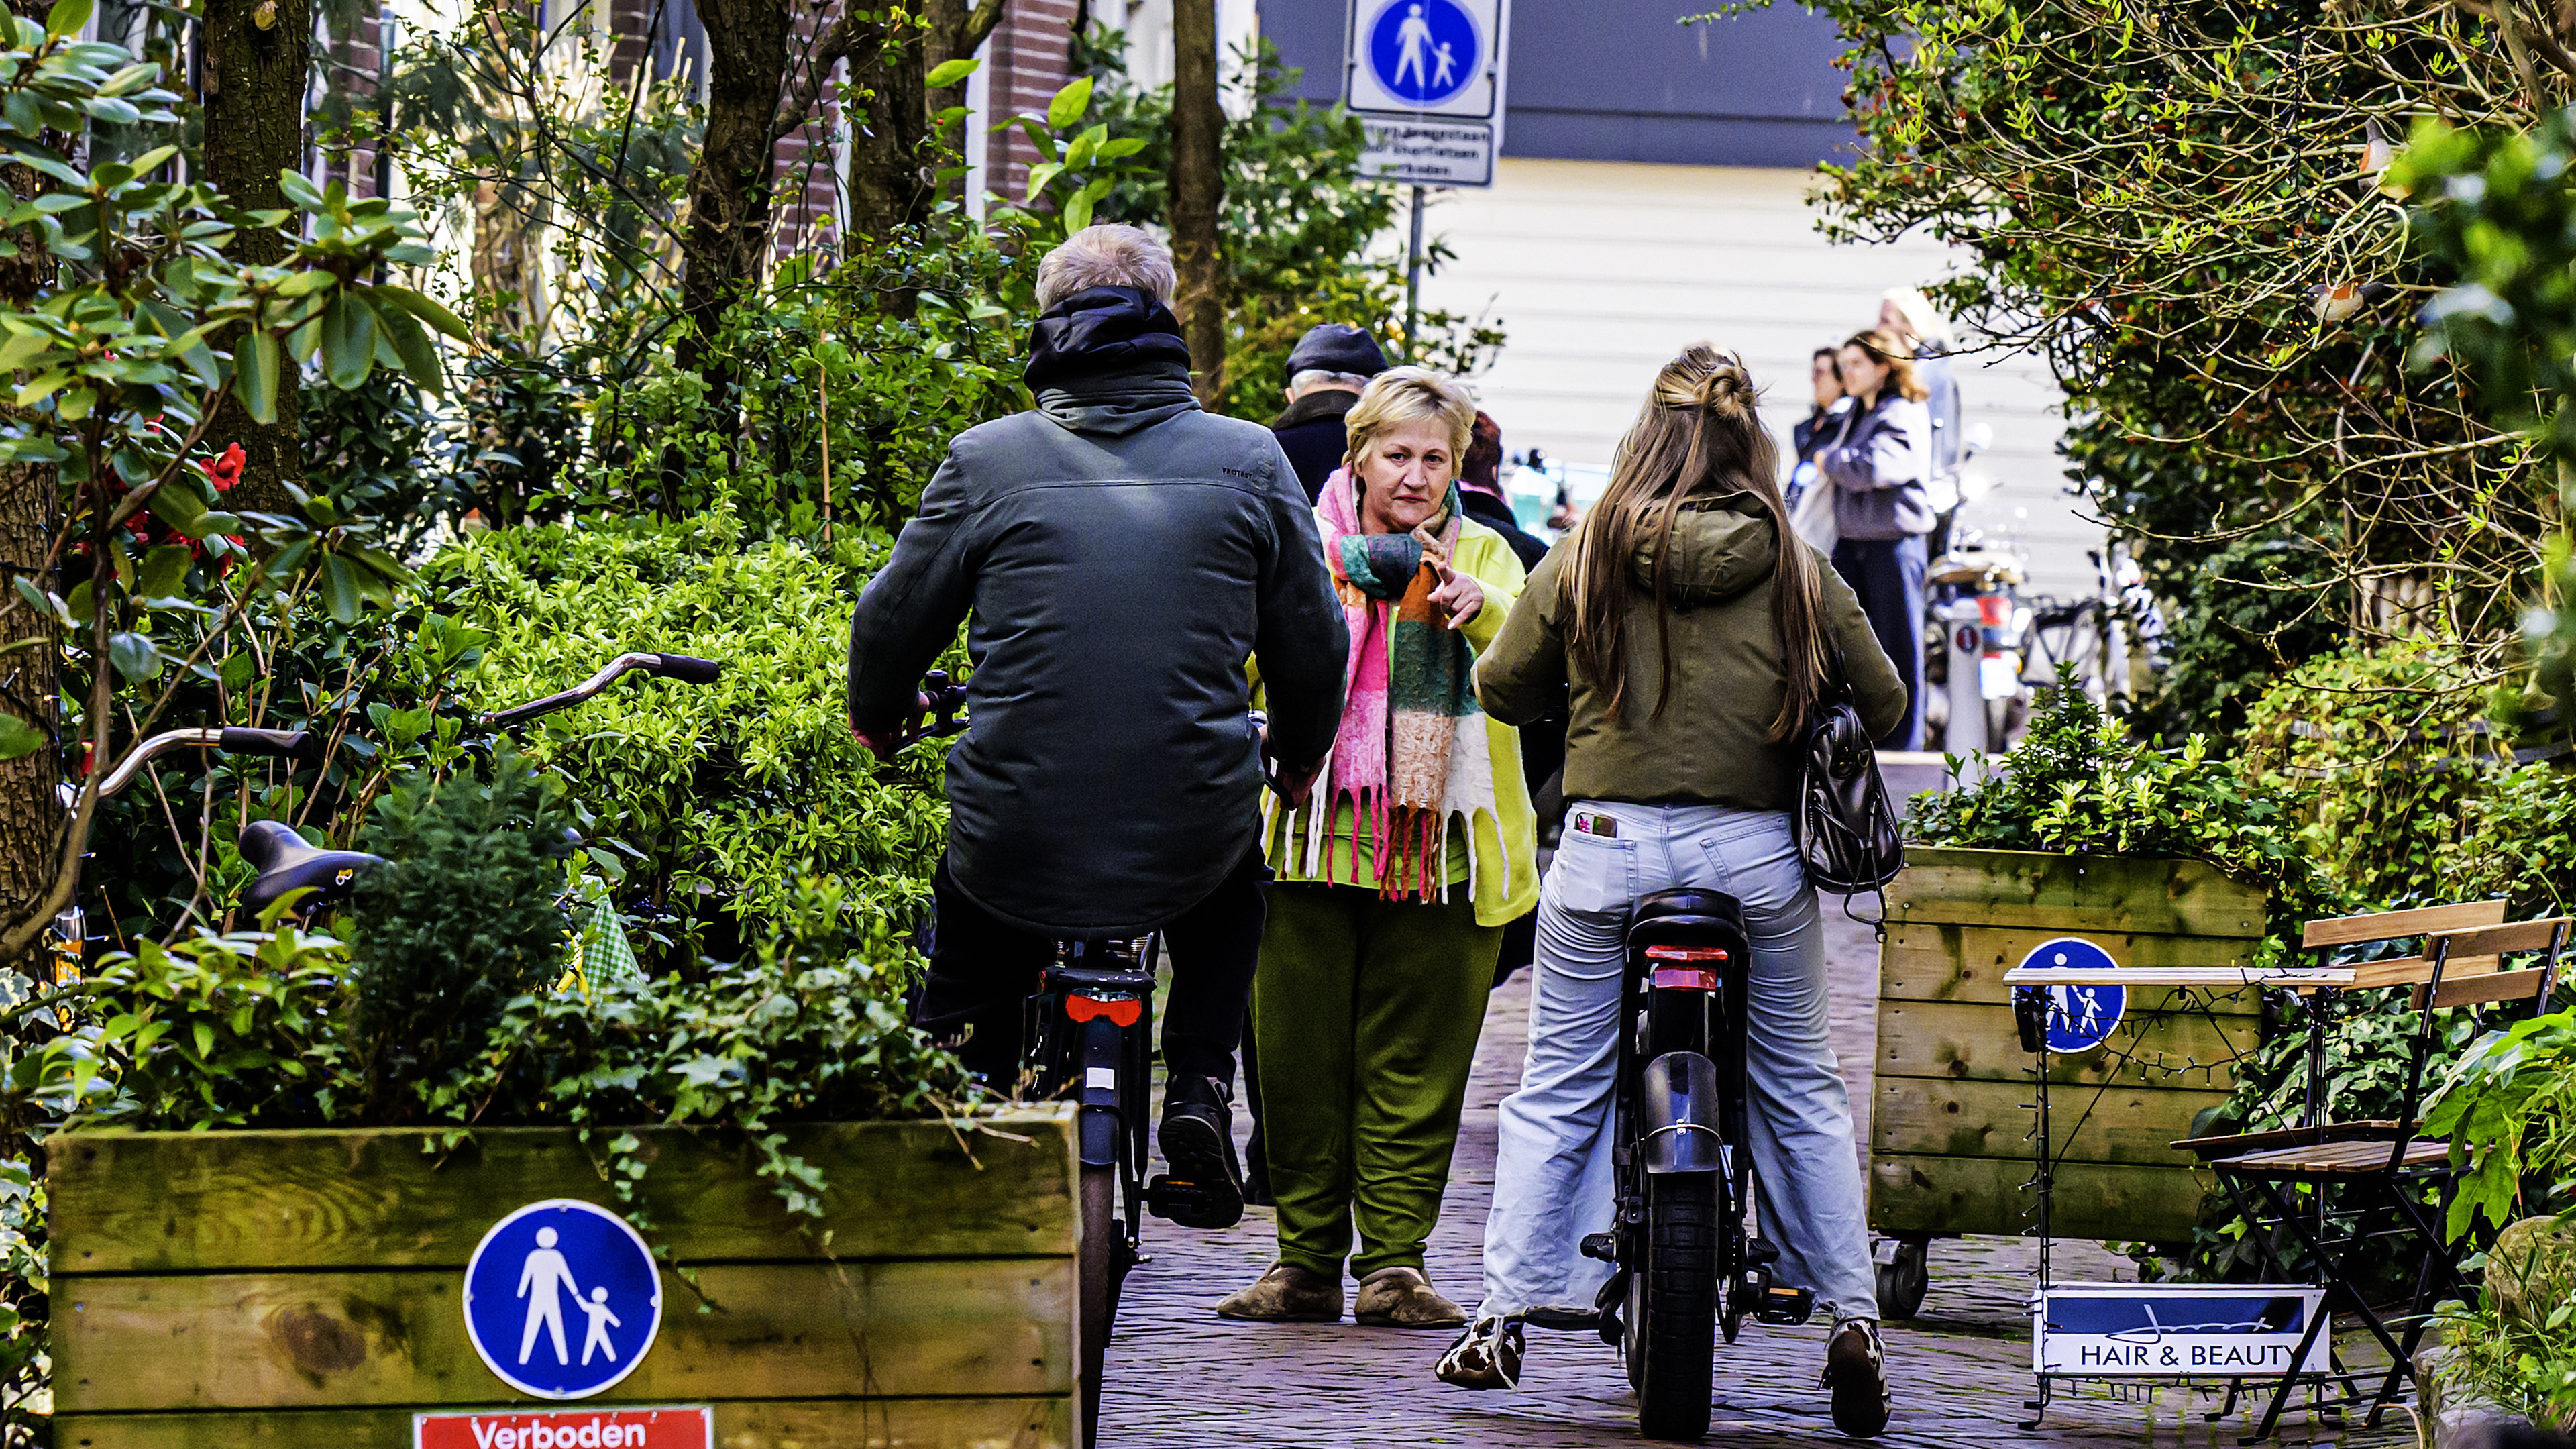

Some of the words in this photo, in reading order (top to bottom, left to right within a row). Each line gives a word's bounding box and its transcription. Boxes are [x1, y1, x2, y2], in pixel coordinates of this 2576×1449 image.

[2081, 1346, 2149, 1366] HAIR
[2159, 1346, 2179, 1366] &
[471, 1417, 646, 1449] Verboden
